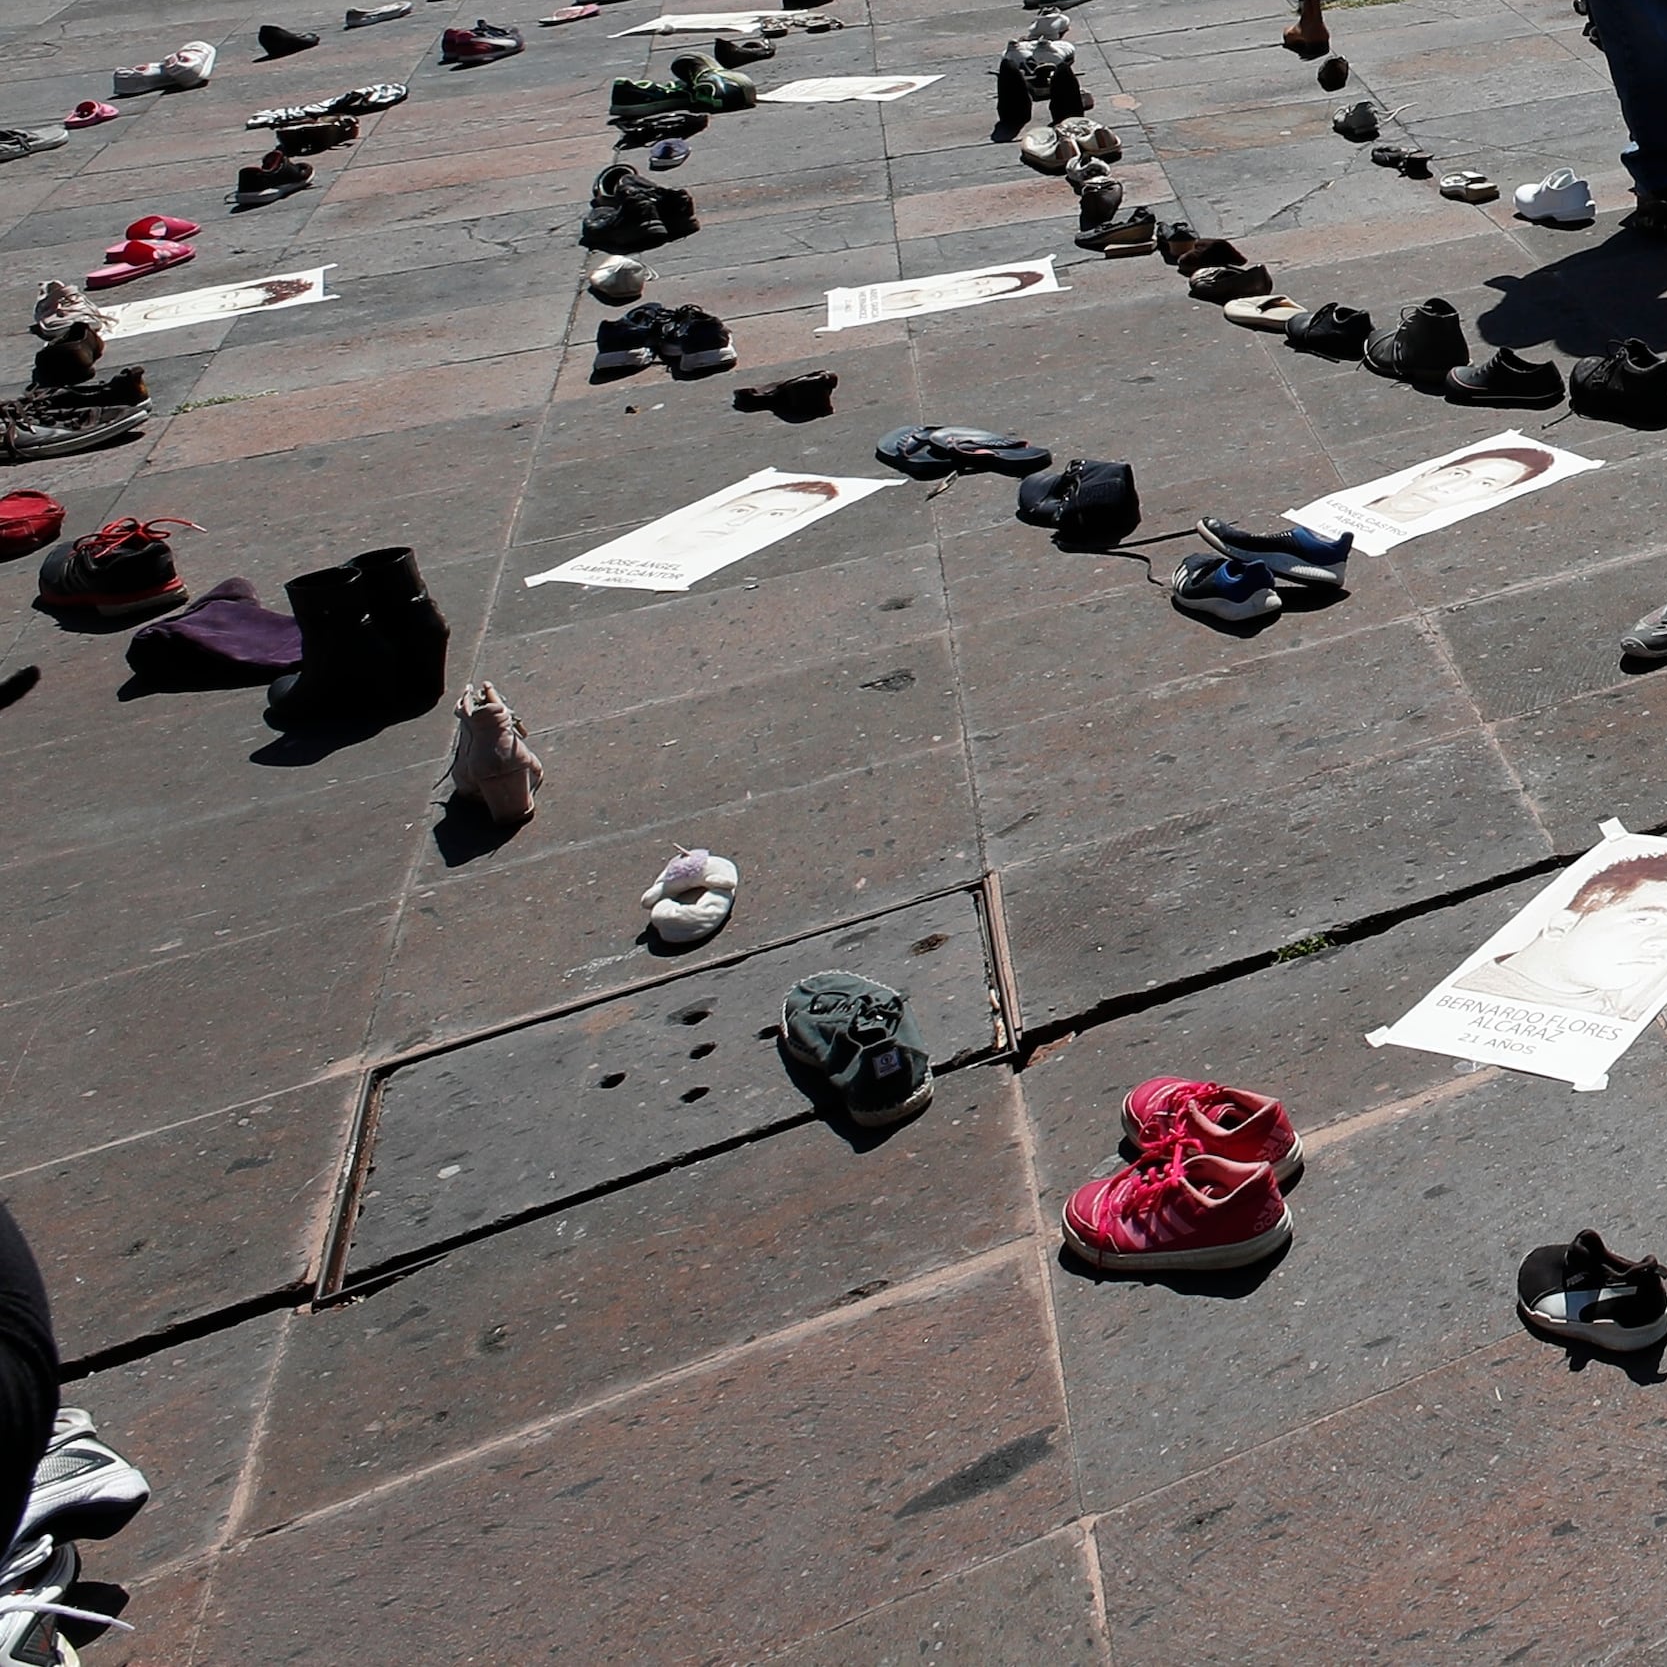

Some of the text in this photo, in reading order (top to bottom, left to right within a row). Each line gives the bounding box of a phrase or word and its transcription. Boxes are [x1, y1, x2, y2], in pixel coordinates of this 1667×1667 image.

[1435, 995, 1624, 1041] BERNARDO FLORES
[1467, 1016, 1565, 1043] ALCARAZ
[1457, 1032, 1538, 1055] 21 AÑOS
